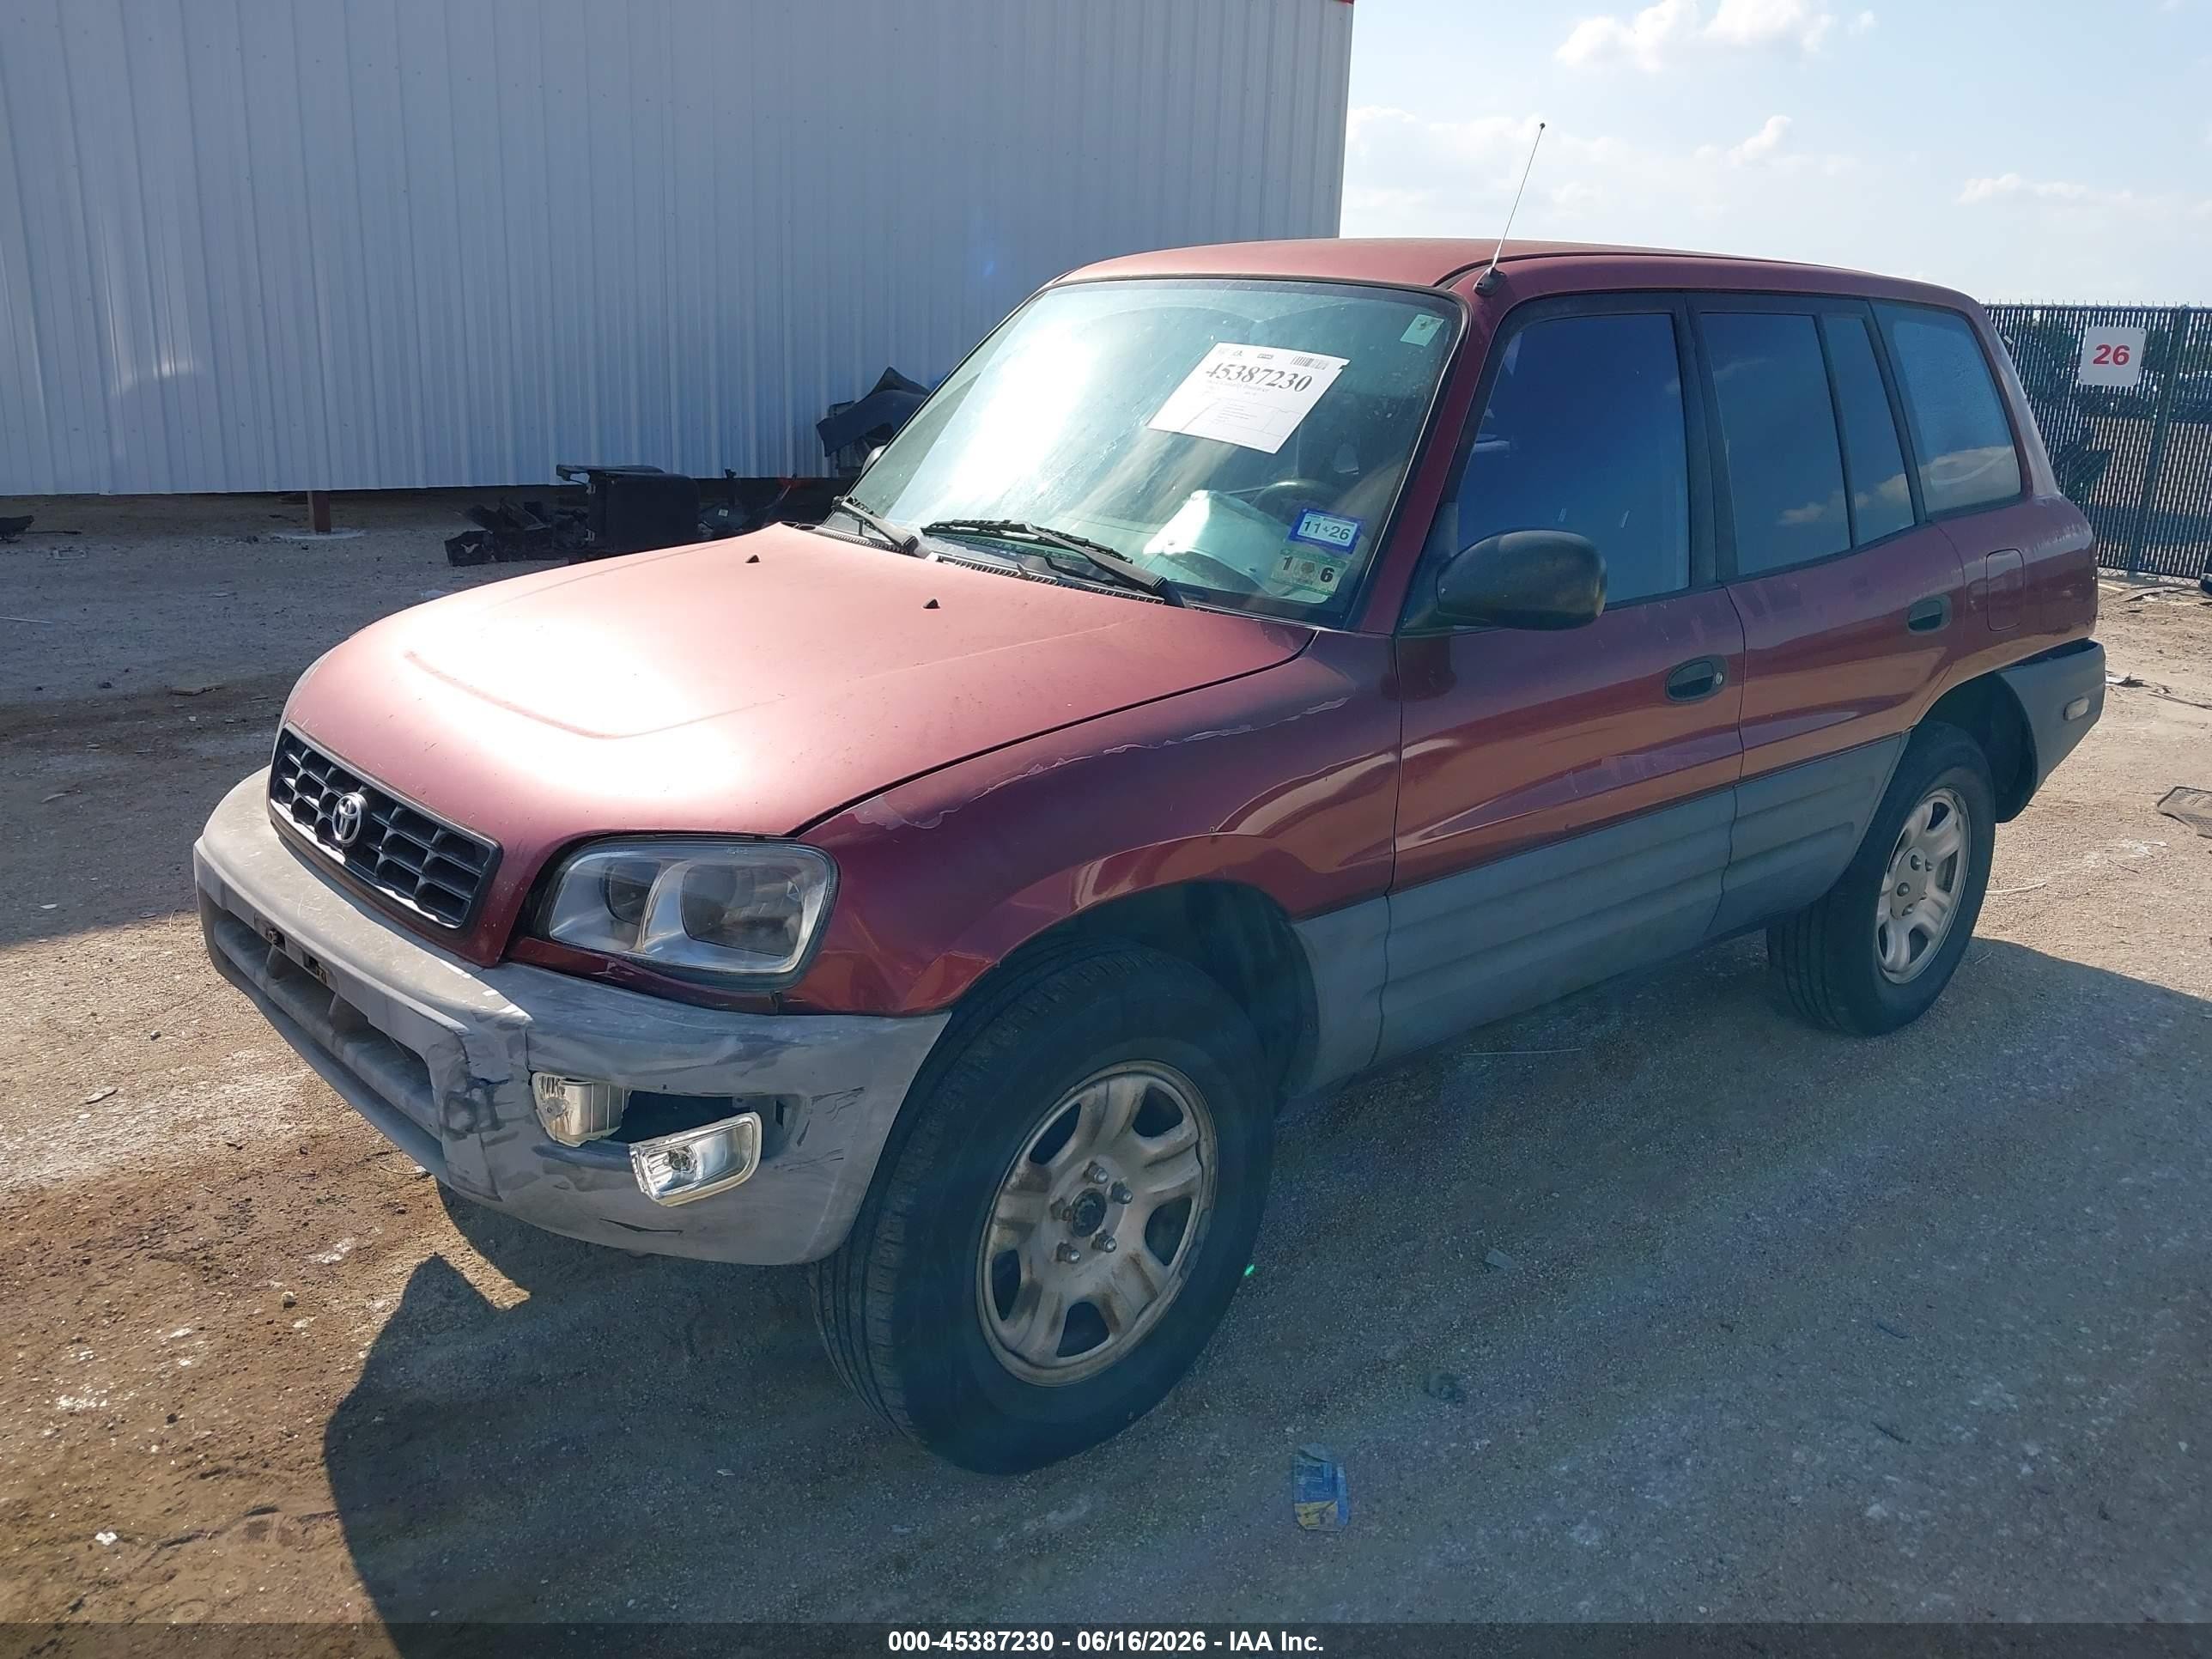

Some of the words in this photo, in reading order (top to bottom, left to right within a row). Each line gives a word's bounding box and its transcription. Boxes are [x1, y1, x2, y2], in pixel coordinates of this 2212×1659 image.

[2093, 343, 2130, 366] 26
[1206, 362, 1313, 392] 45387230
[1304, 520, 1322, 534] 11
[1328, 526, 1351, 540] 26
[1320, 567, 1335, 583] 6
